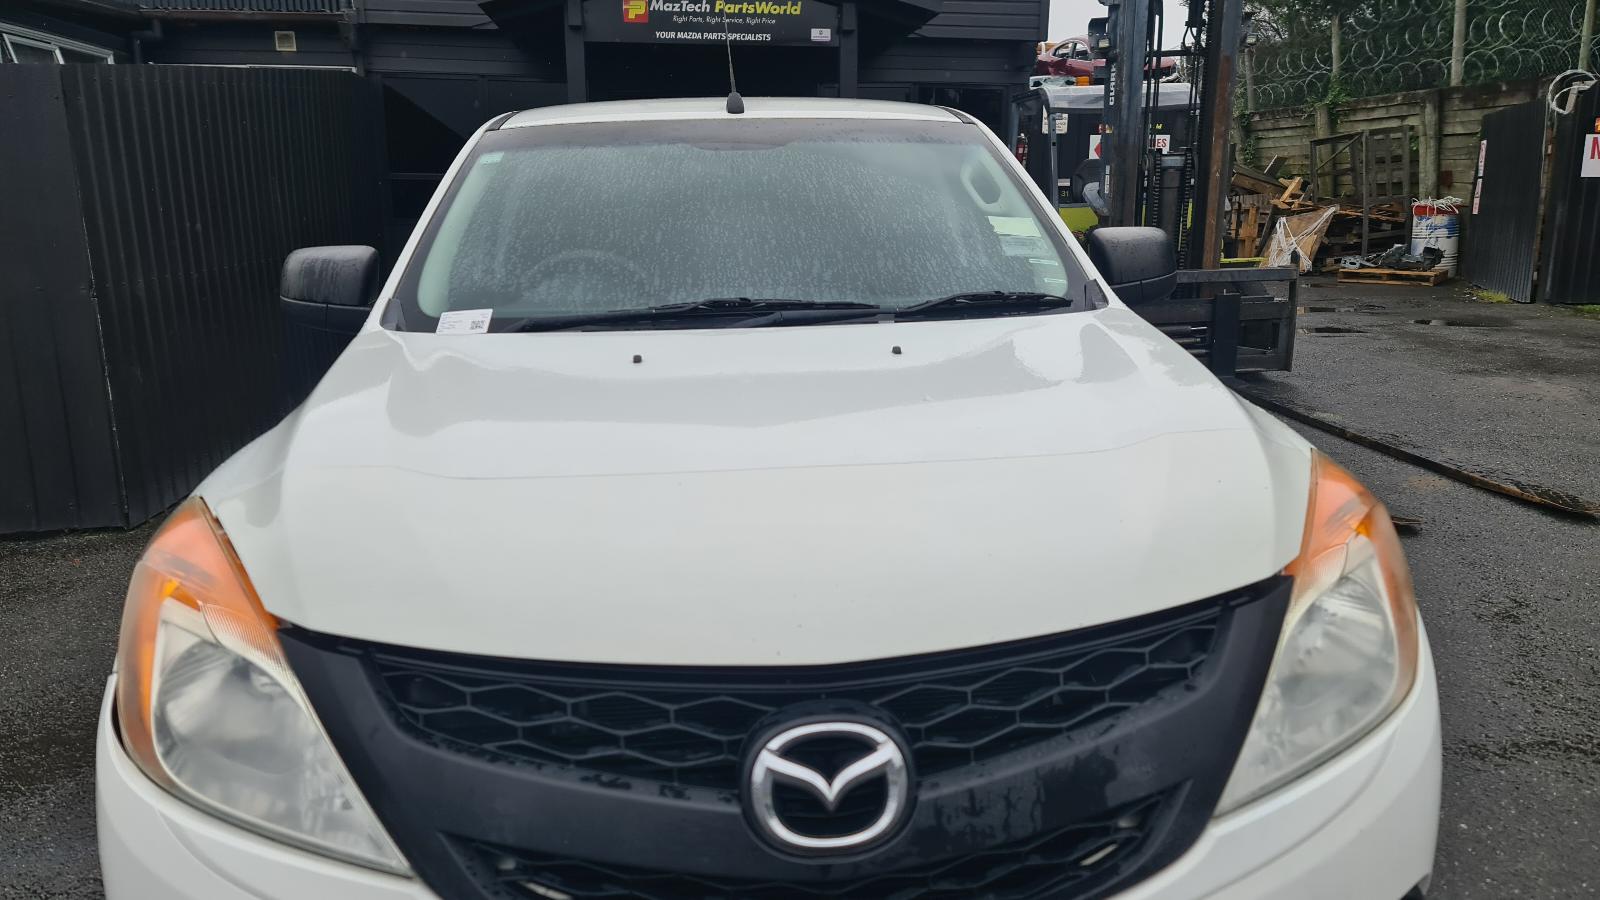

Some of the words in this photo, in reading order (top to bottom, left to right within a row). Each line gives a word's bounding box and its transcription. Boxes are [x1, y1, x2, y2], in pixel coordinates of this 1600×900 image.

[649, 0, 710, 12] MazTech
[714, 0, 801, 15] PartsWorld
[672, 15, 688, 24] Right
[706, 16, 721, 25] Right
[746, 17, 761, 26] Right
[761, 17, 776, 25] Price
[655, 31, 676, 39] YOUR
[676, 31, 702, 39] MAZDA
[703, 32, 726, 40] PARTS
[727, 33, 771, 41] SPECIALISTS
